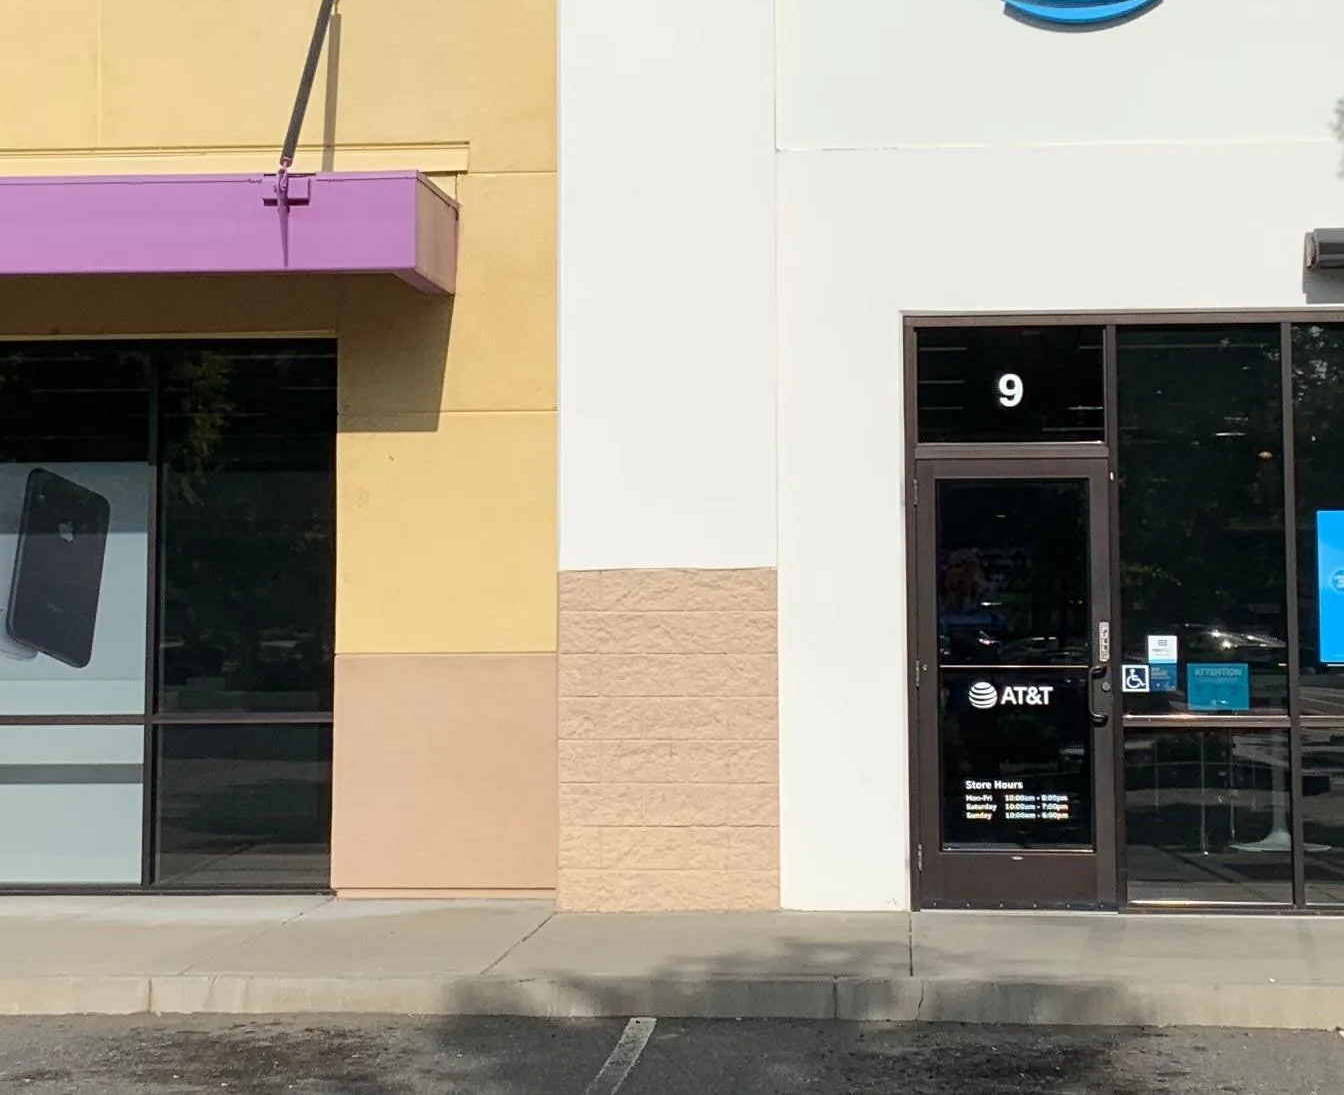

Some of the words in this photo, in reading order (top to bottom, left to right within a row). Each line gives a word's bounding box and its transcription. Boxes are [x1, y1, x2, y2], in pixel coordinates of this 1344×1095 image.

[998, 373, 1024, 407] 9
[1194, 667, 1243, 676] ATTENTION
[1000, 686, 1054, 705] AT&T
[965, 780, 992, 789] Store
[994, 780, 1023, 789] Hours
[965, 794, 993, 802] Mon-Fri
[965, 803, 997, 812] Saturday
[966, 812, 993, 821] Sunday
